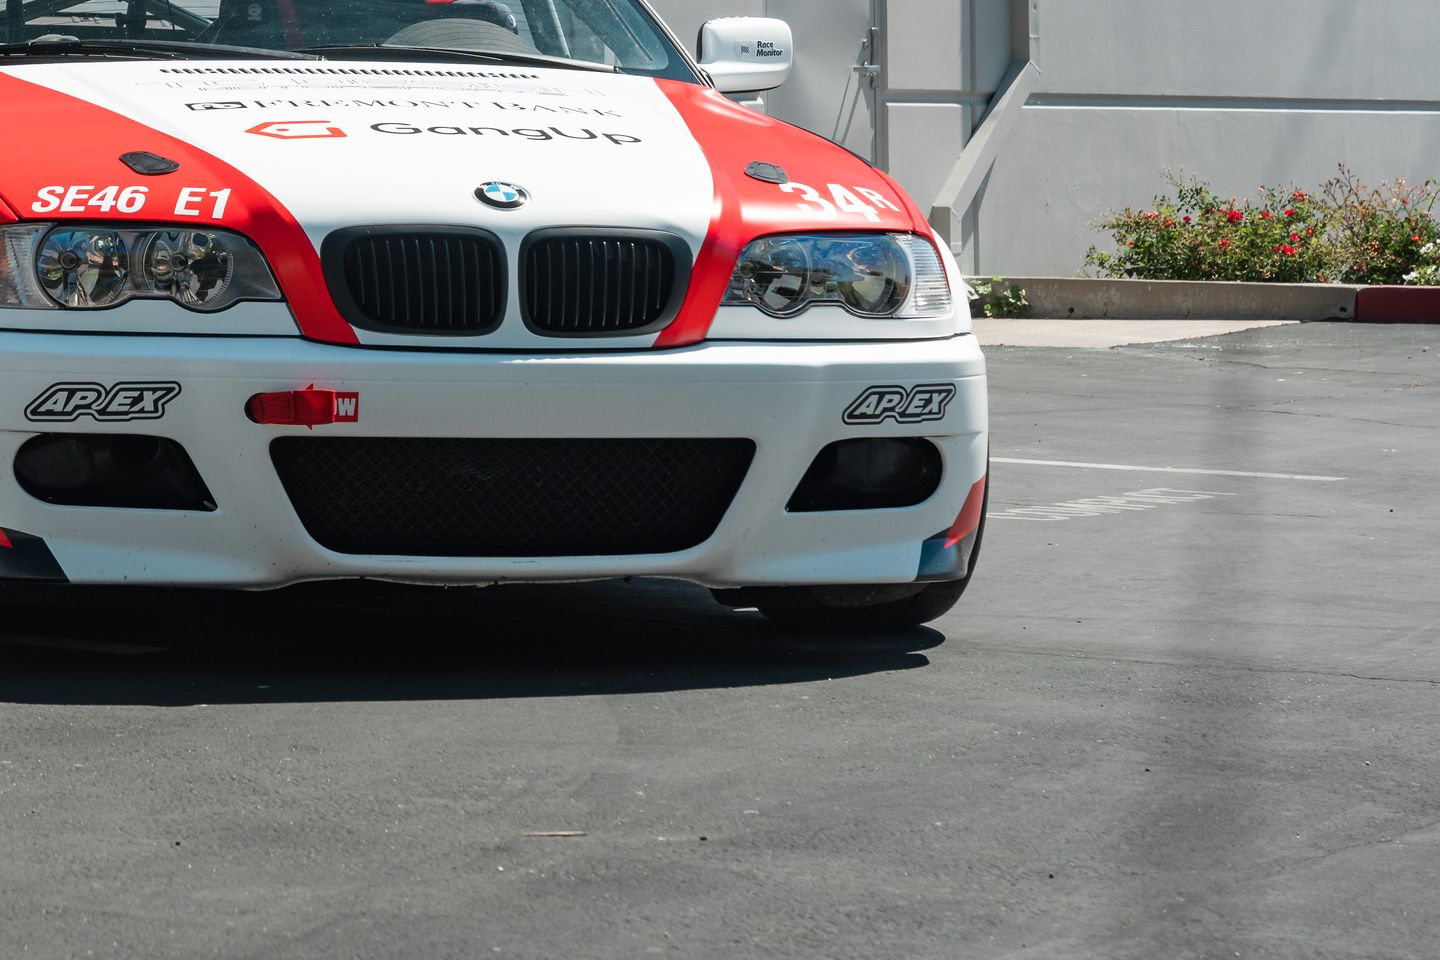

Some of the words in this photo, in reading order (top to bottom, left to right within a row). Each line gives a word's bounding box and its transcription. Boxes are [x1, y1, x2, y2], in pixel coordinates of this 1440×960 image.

[756, 48, 784, 57] Monitor
[757, 40, 774, 49] Race
[370, 122, 642, 146] GangUp
[31, 185, 149, 214] SE46
[173, 187, 232, 219] E1
[35, 388, 171, 415] APEX
[850, 390, 951, 417] APEX
